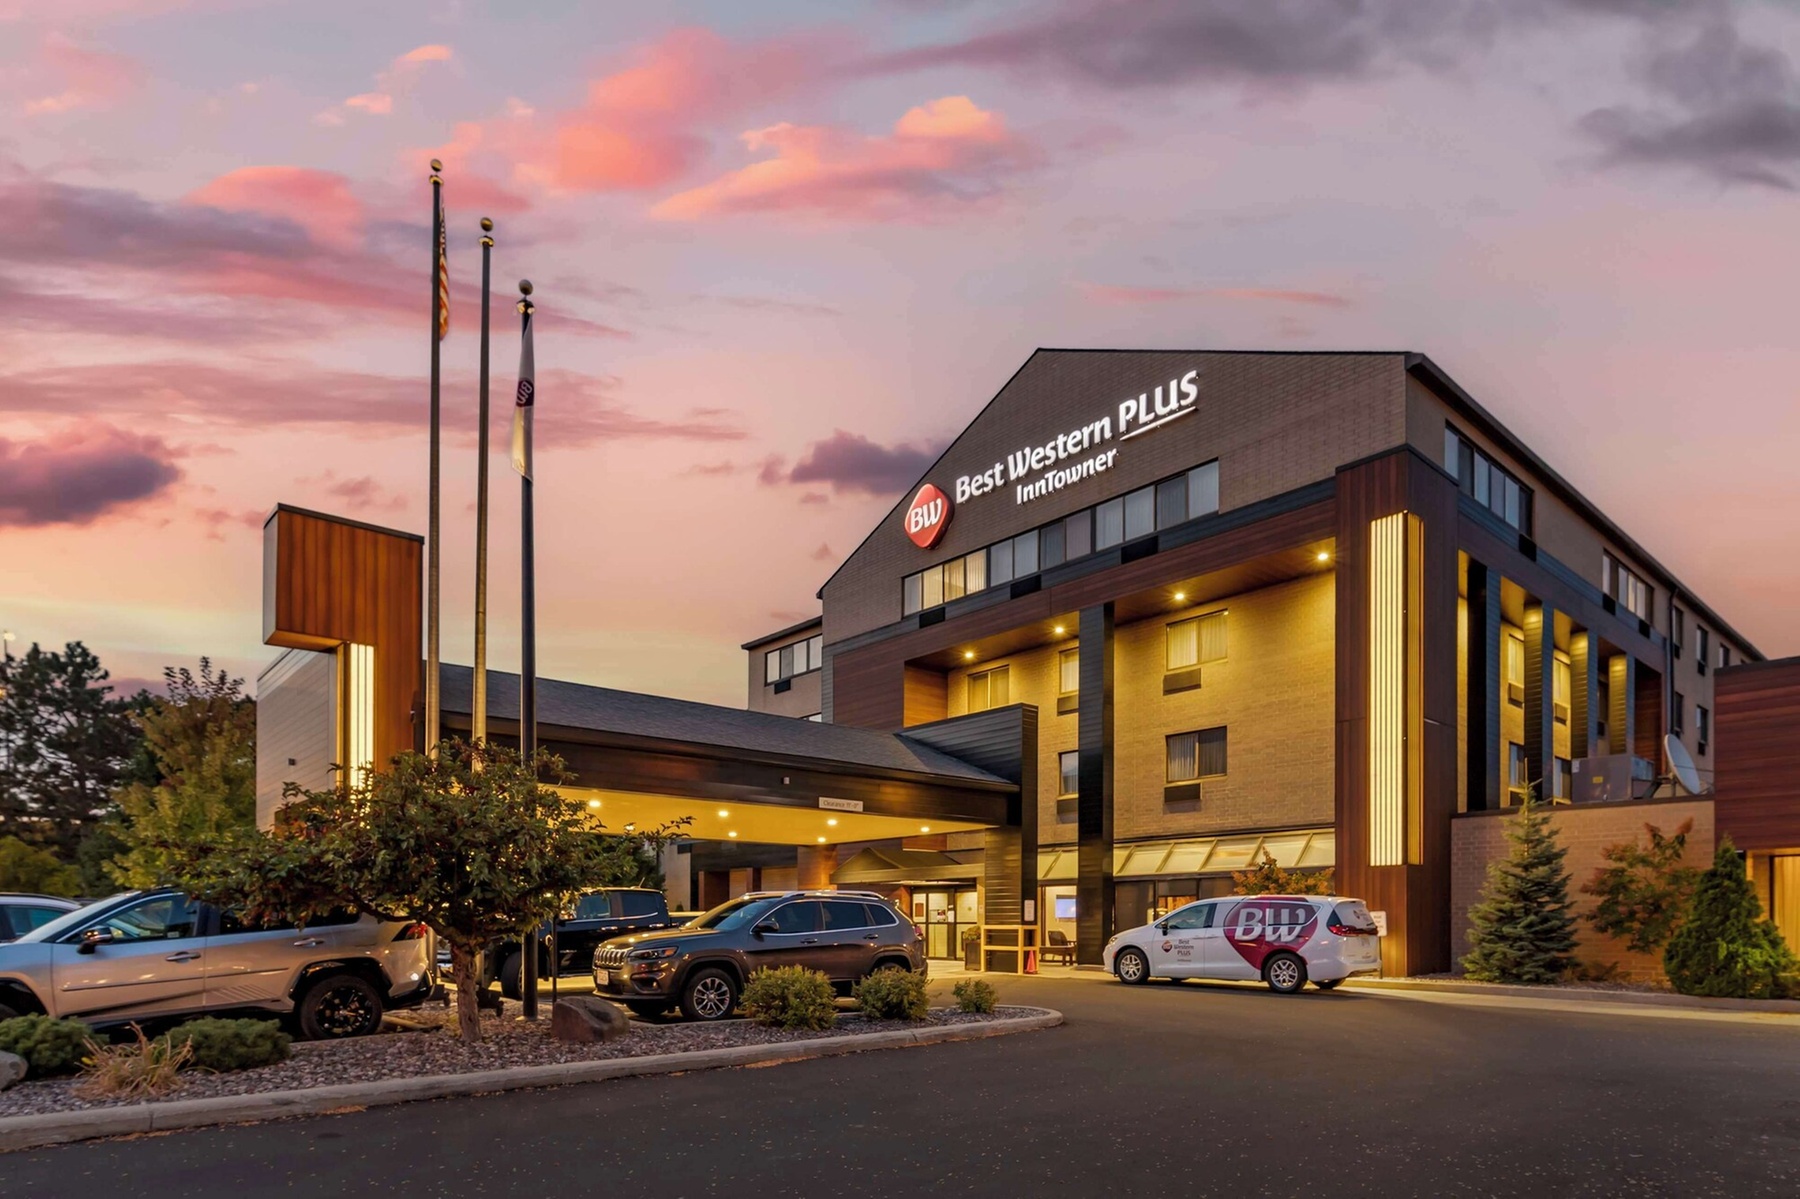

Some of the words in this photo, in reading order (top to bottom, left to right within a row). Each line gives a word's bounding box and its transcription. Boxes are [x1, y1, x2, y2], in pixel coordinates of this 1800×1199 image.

[956, 462, 1005, 504] Best
[1007, 416, 1113, 481] Western
[1119, 370, 1198, 433] PLUS
[1016, 448, 1117, 505] InnTowner
[910, 498, 942, 534] BW
[1234, 908, 1306, 942] BW
